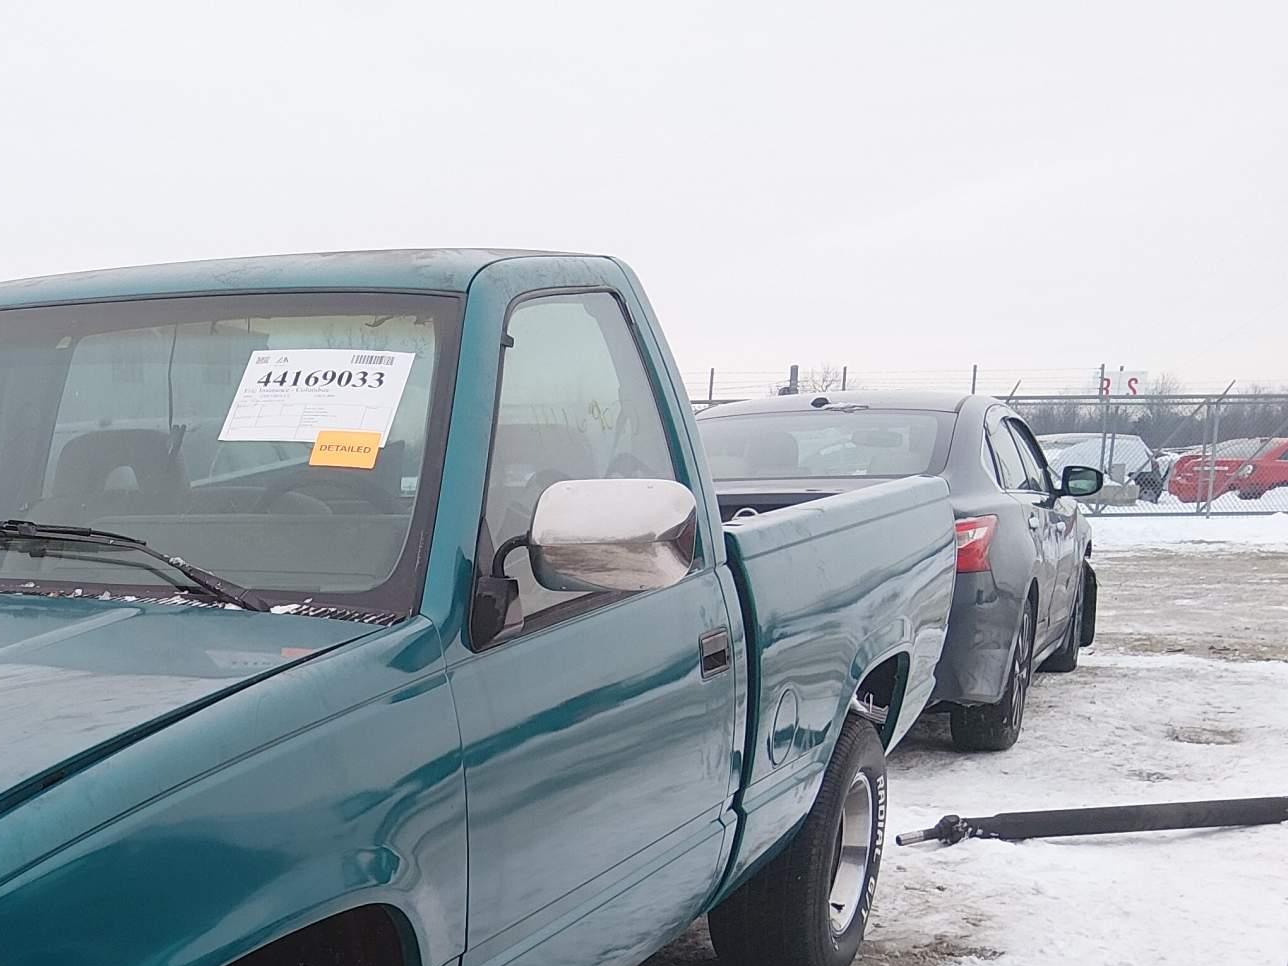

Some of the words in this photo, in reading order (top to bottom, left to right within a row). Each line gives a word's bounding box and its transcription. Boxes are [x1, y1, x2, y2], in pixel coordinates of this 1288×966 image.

[257, 369, 385, 388] 44169033
[319, 444, 372, 454] DETAILED
[873, 775, 887, 862] RADIAL
